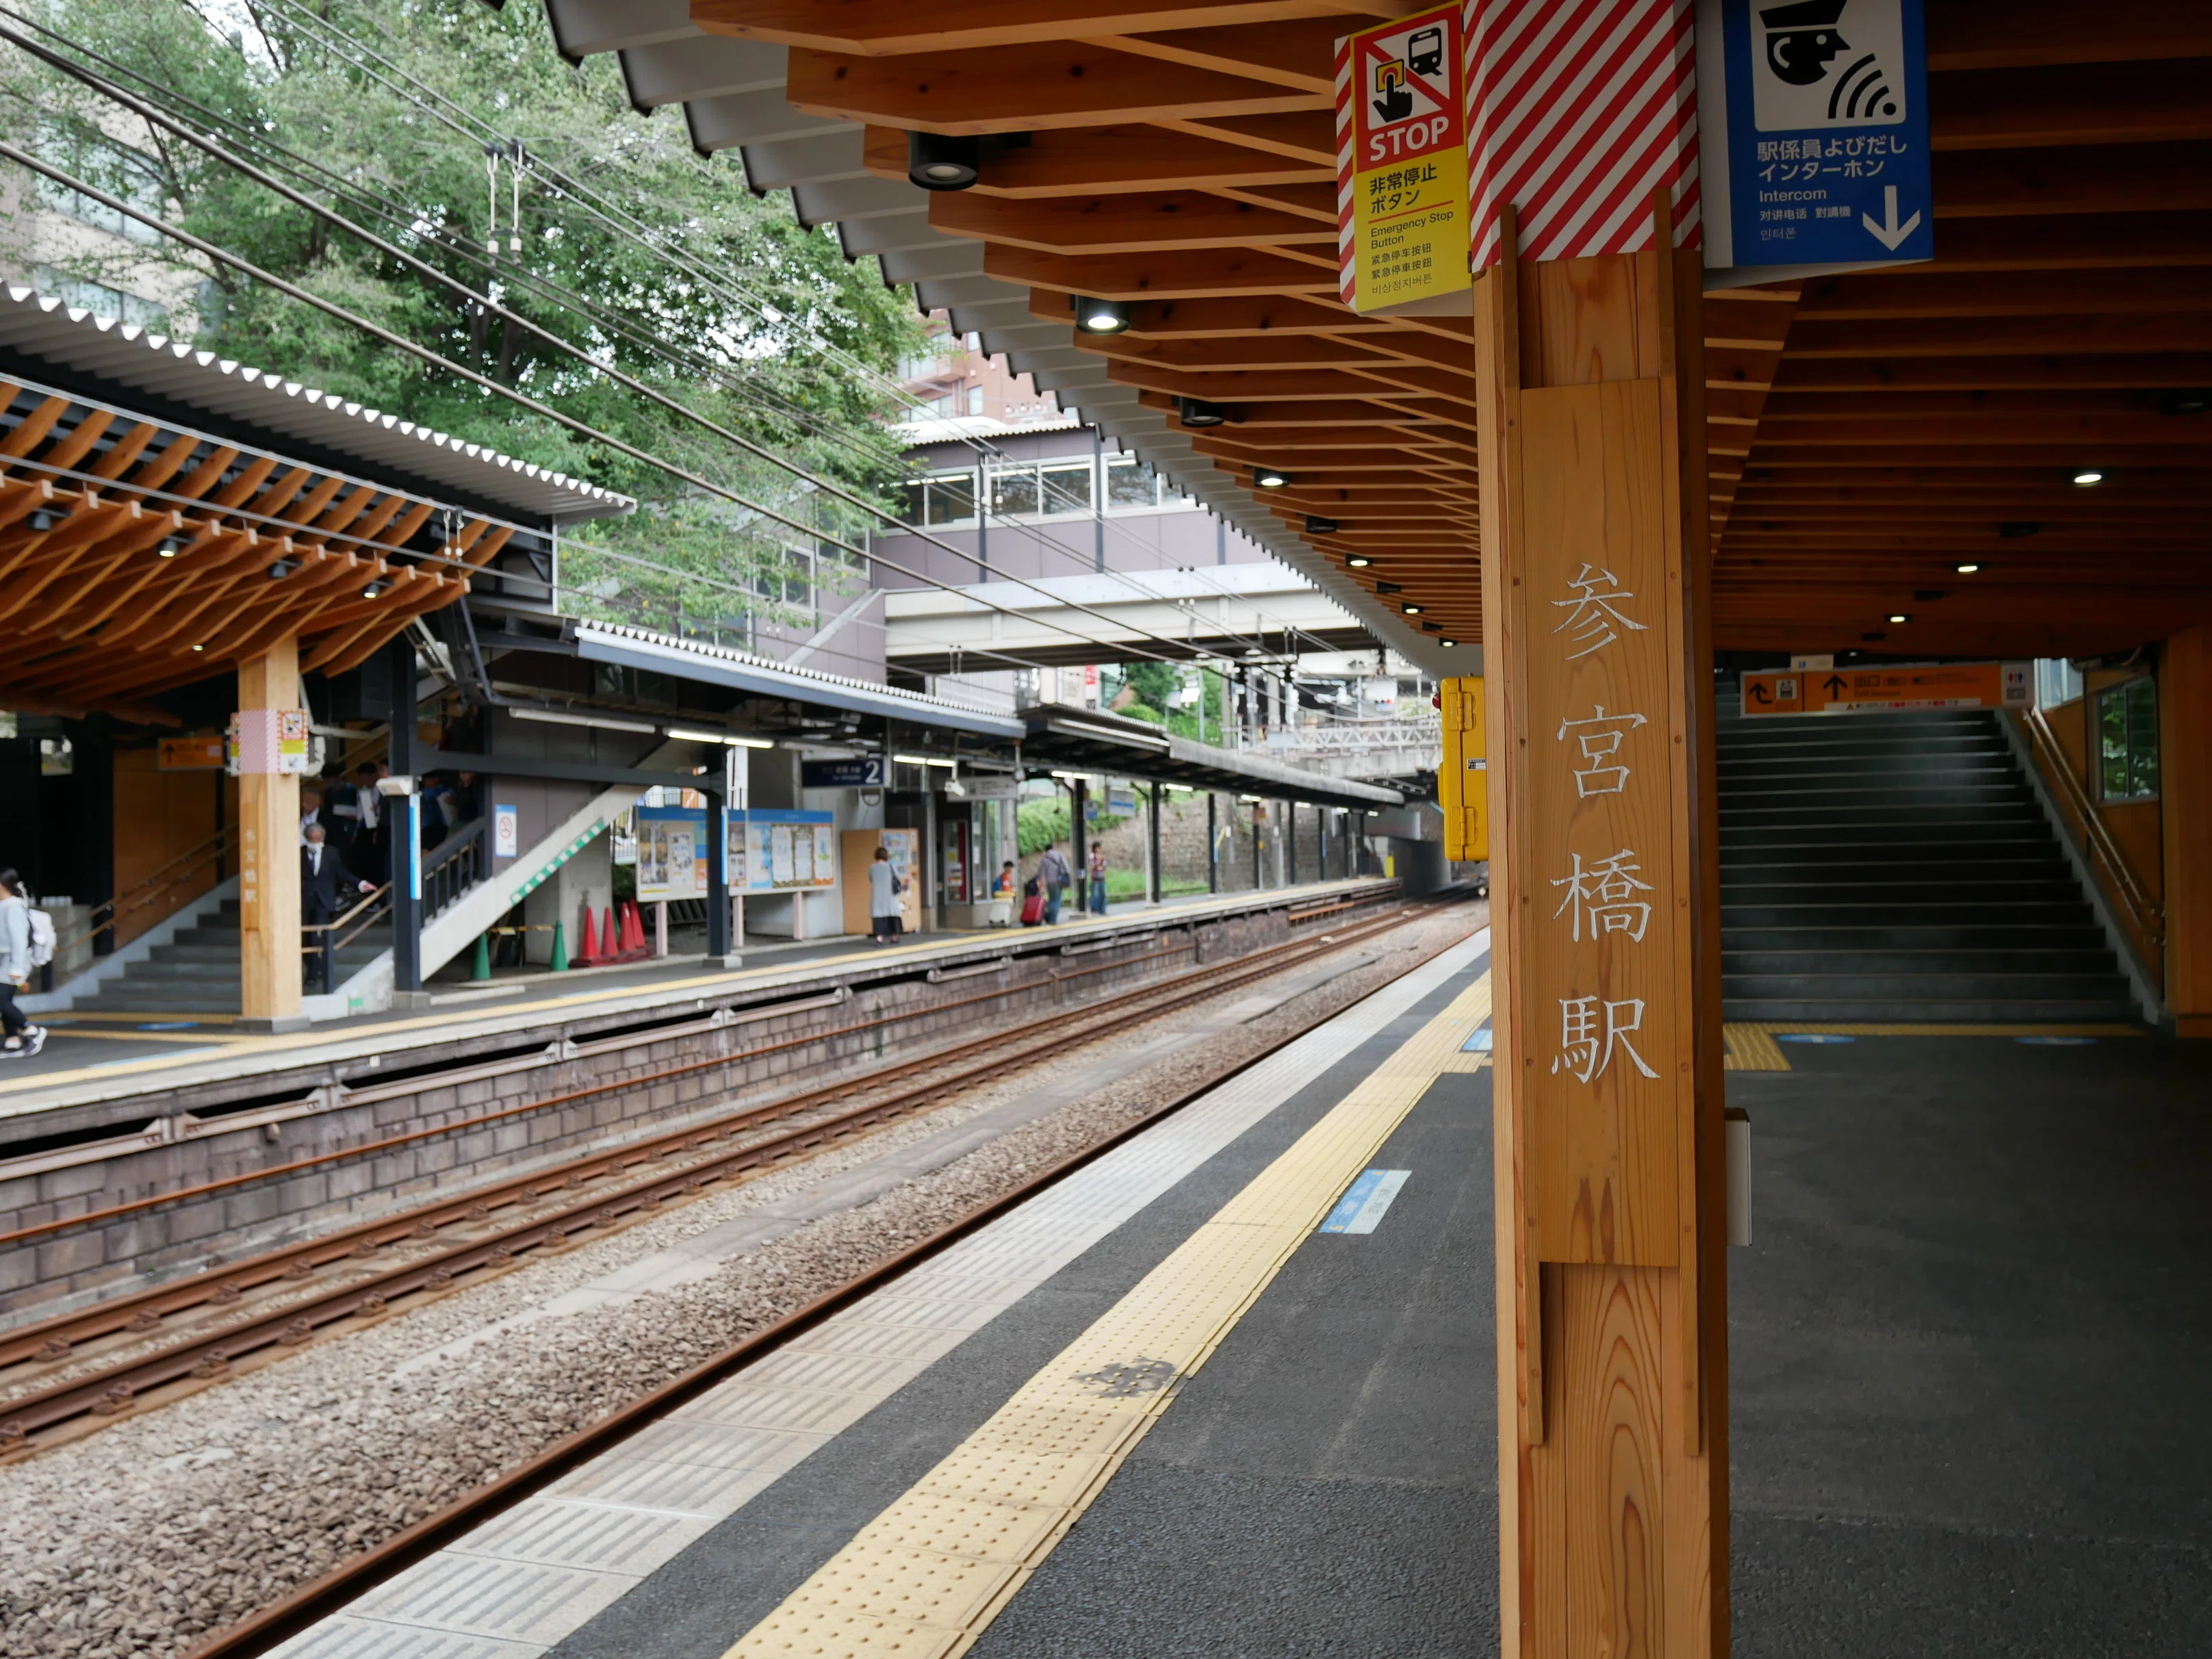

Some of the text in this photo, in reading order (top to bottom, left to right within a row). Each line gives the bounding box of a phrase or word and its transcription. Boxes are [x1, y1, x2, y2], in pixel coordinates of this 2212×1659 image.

[1369, 115, 1450, 162] STOP
[1757, 135, 1907, 162] 駅係員よびだし
[1369, 162, 1438, 196] 非常停止
[1758, 159, 1885, 183] インターホン
[1371, 189, 1420, 214] ボタン
[1759, 188, 1827, 203] Intercom
[1370, 209, 1454, 238] Emergency Stop
[1371, 234, 1404, 250] Button
[1371, 242, 1432, 266] 紧急停车按钮
[1372, 273, 1432, 295] 비상정지버튼
[864, 760, 880, 783] 2
[1549, 562, 1661, 1085] 参宮橋駅
